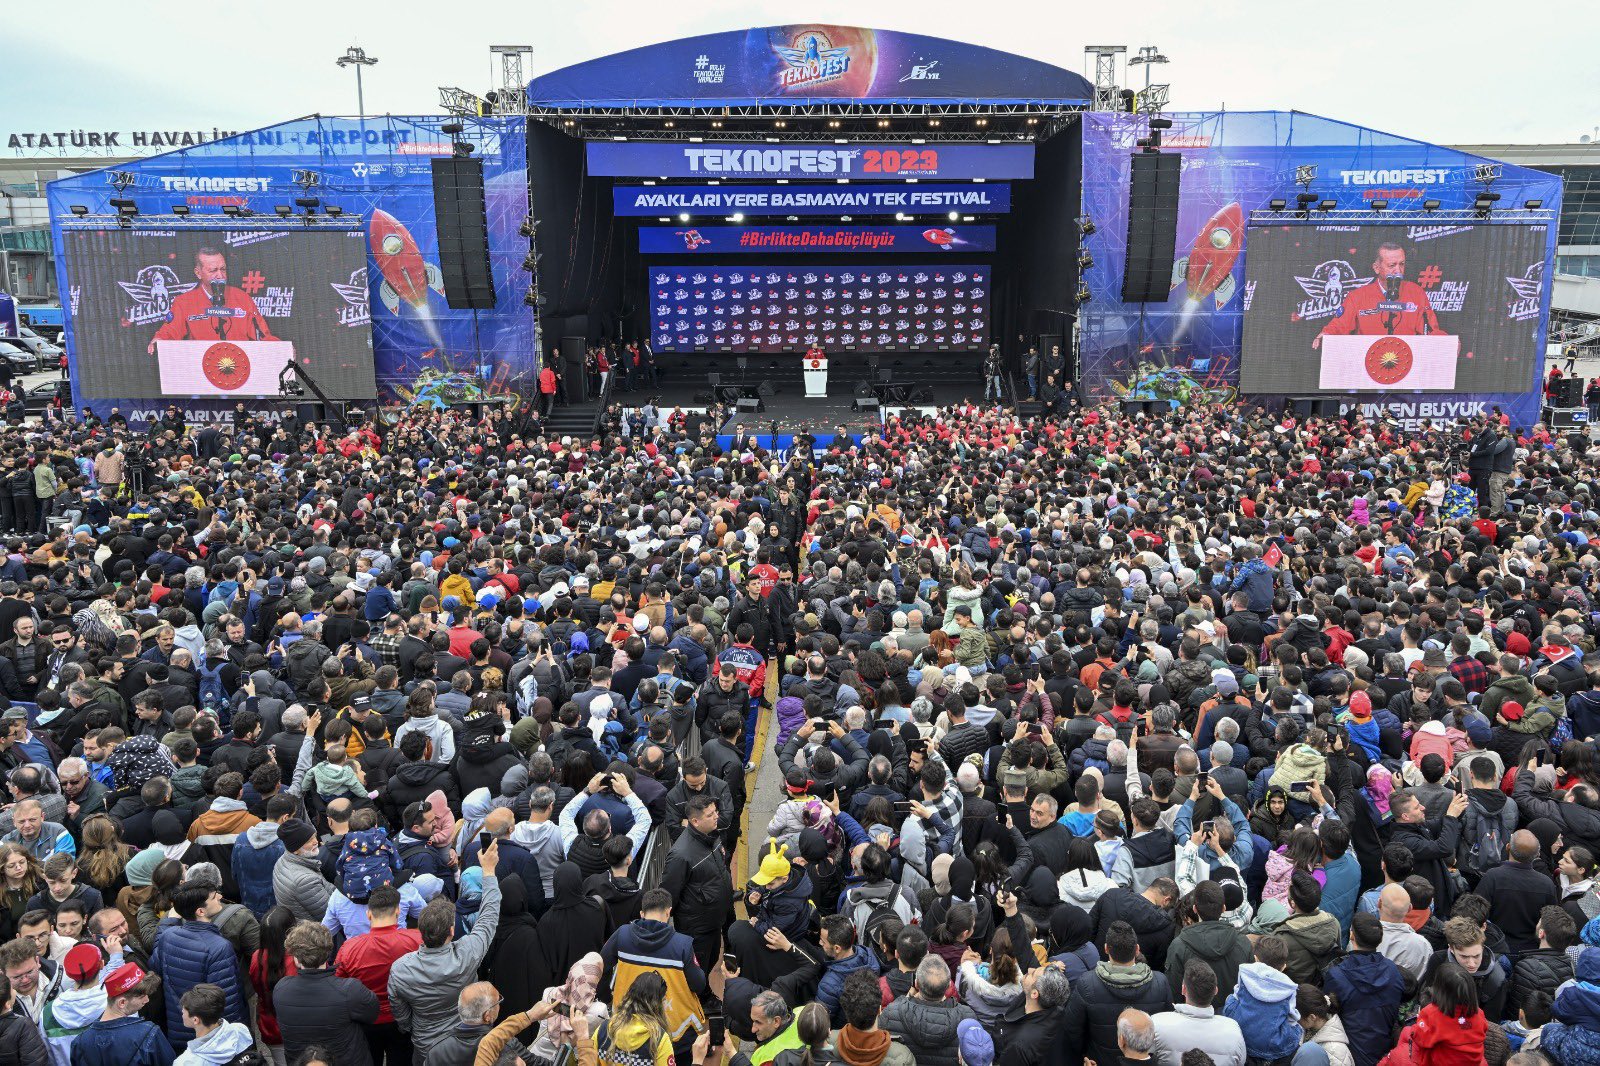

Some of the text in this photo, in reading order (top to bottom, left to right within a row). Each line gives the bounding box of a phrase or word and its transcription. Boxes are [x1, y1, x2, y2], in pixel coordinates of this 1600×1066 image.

[780, 56, 851, 87] TEKNOFEST
[7, 128, 120, 148] ATATÜRK
[132, 127, 284, 147] HAVALİMANI
[305, 129, 412, 147] AIRPORT
[684, 149, 938, 173] TEKNOFEST 2023
[160, 176, 271, 192] TEKNOFEST
[1340, 169, 1450, 185] TEKNOFEST
[634, 191, 991, 207] AYAKLARI YERE BASMAYAN TEK FESTİVAL
[740, 231, 896, 249] #BirlikteDahaGüçlüyüz
[266, 286, 294, 297] MİLLİ
[1441, 281, 1469, 292] MİLLİ
[252, 296, 293, 307] KNOLOJİ
[1389, 402, 1417, 417] EN
